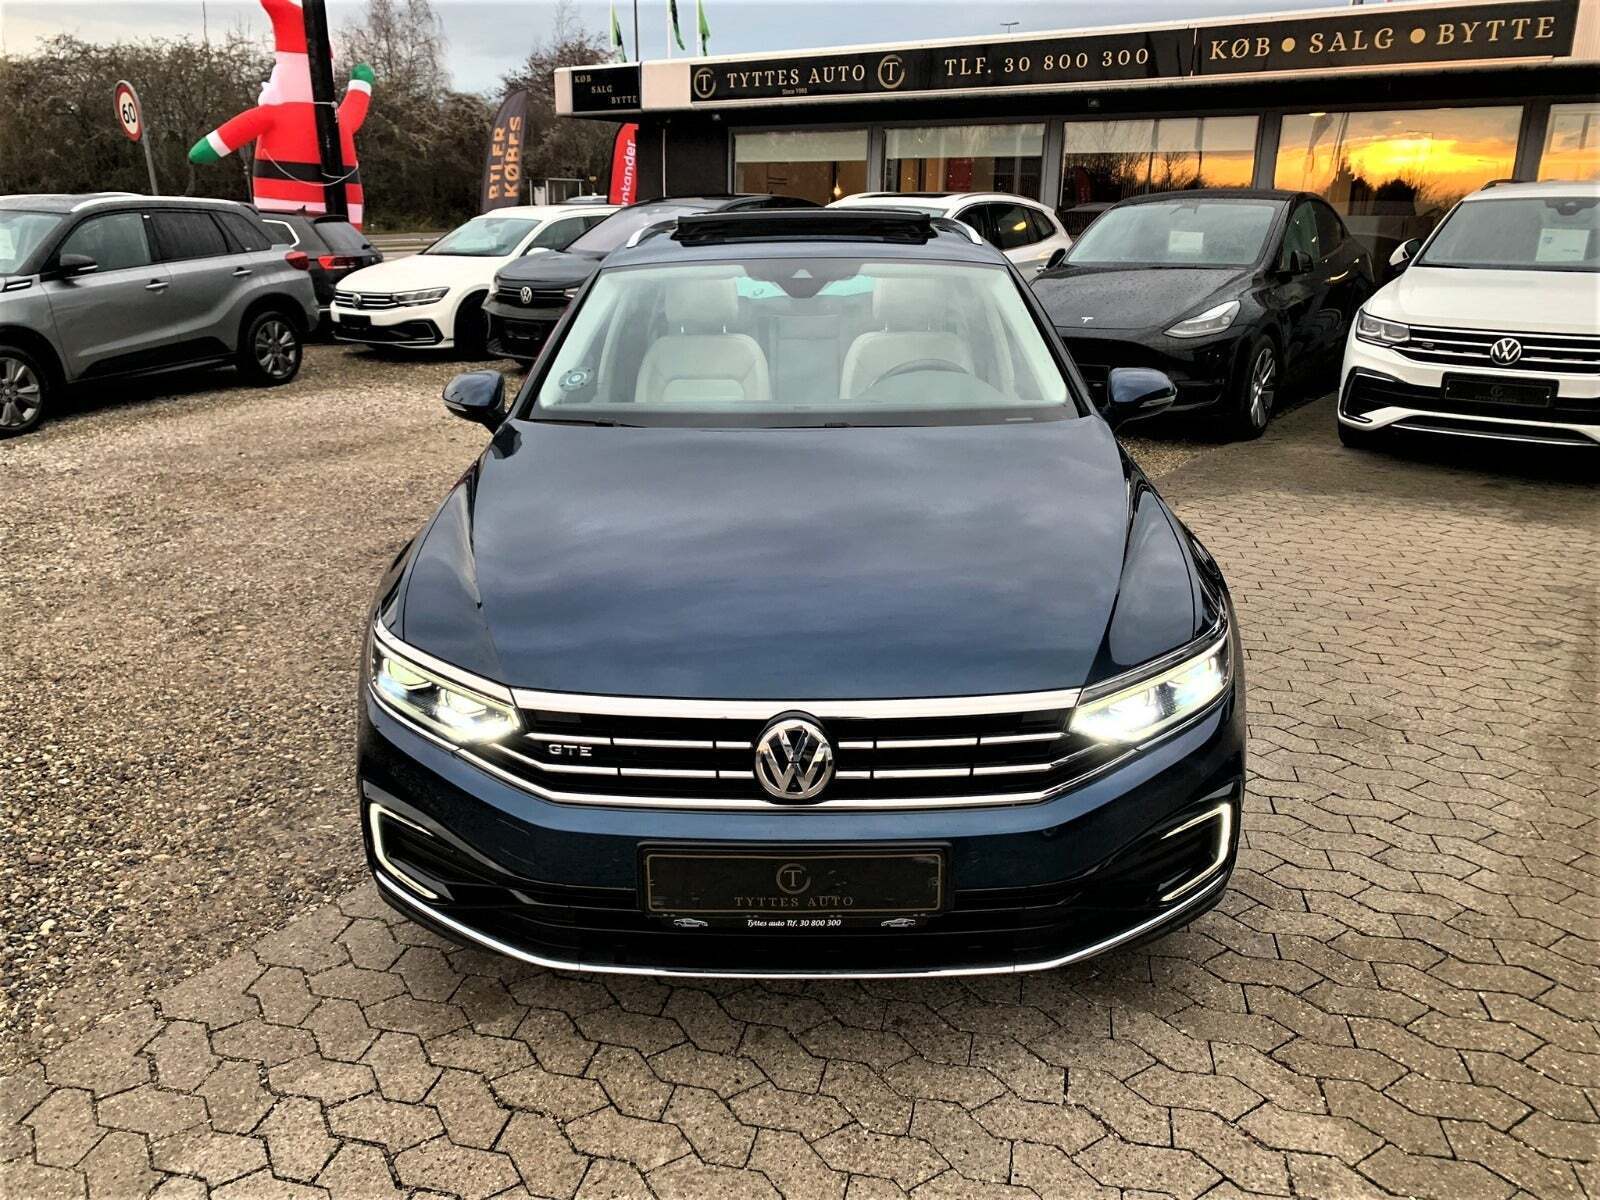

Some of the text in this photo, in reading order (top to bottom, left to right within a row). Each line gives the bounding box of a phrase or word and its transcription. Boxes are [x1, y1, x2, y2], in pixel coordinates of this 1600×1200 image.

[1209, 16, 1555, 60] KØB SALG BYTTE
[945, 48, 1149, 76] TLF. 30 800 300
[727, 64, 866, 88] TYTTES AUTO
[591, 85, 612, 94] SALG
[122, 102, 136, 124] 60
[549, 743, 592, 757] GTE
[734, 895, 854, 907] TYTTES AUTO
[799, 919, 810, 927] 30
[810, 919, 826, 927] 800
[826, 919, 842, 927] 300
